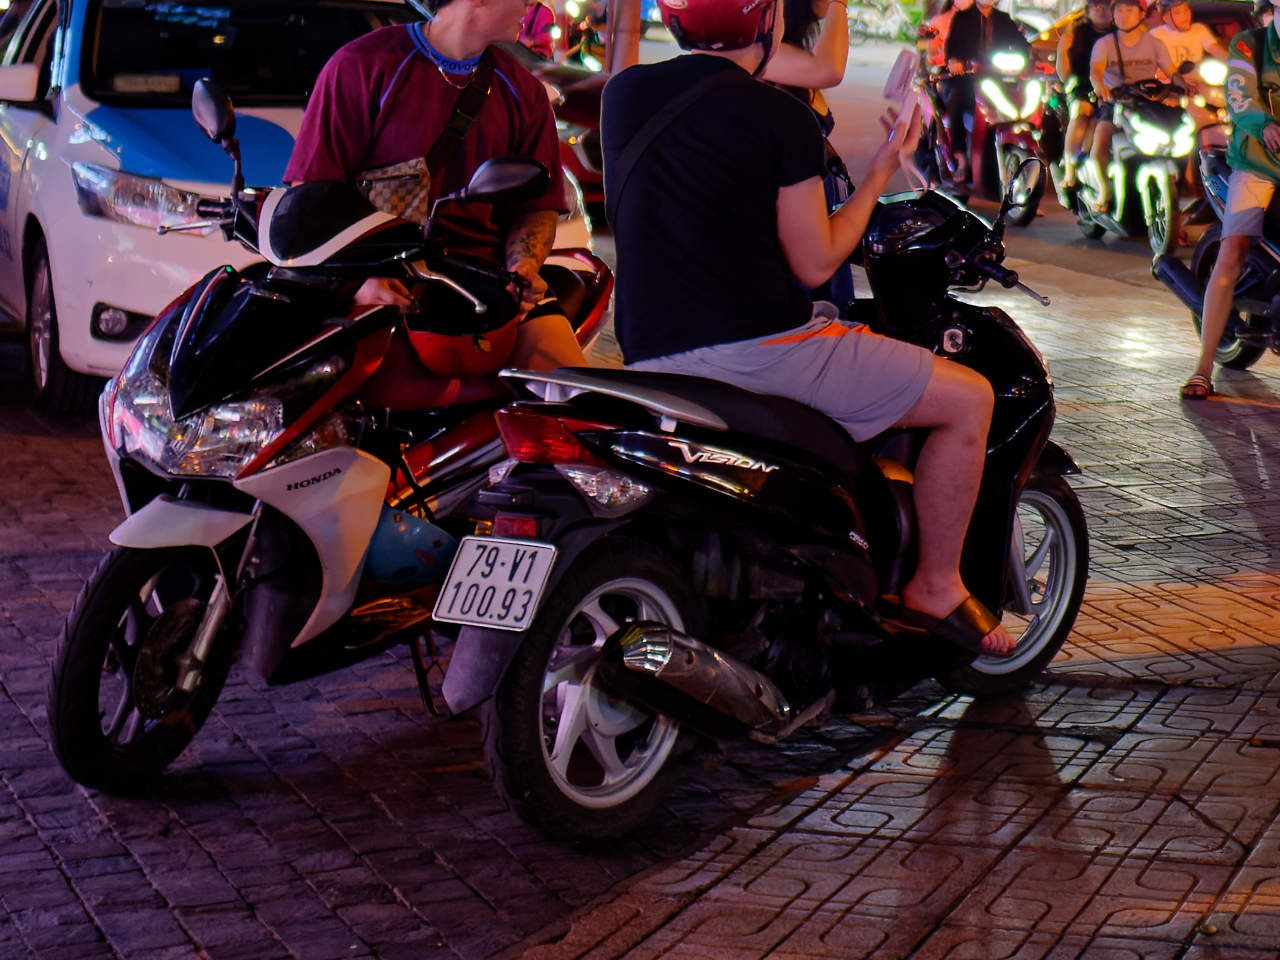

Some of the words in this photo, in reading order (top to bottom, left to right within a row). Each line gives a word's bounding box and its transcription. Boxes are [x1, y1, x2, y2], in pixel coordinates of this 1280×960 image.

[668, 441, 780, 473] VISION
[286, 466, 342, 491] HONDA
[447, 581, 533, 623] 100.93
